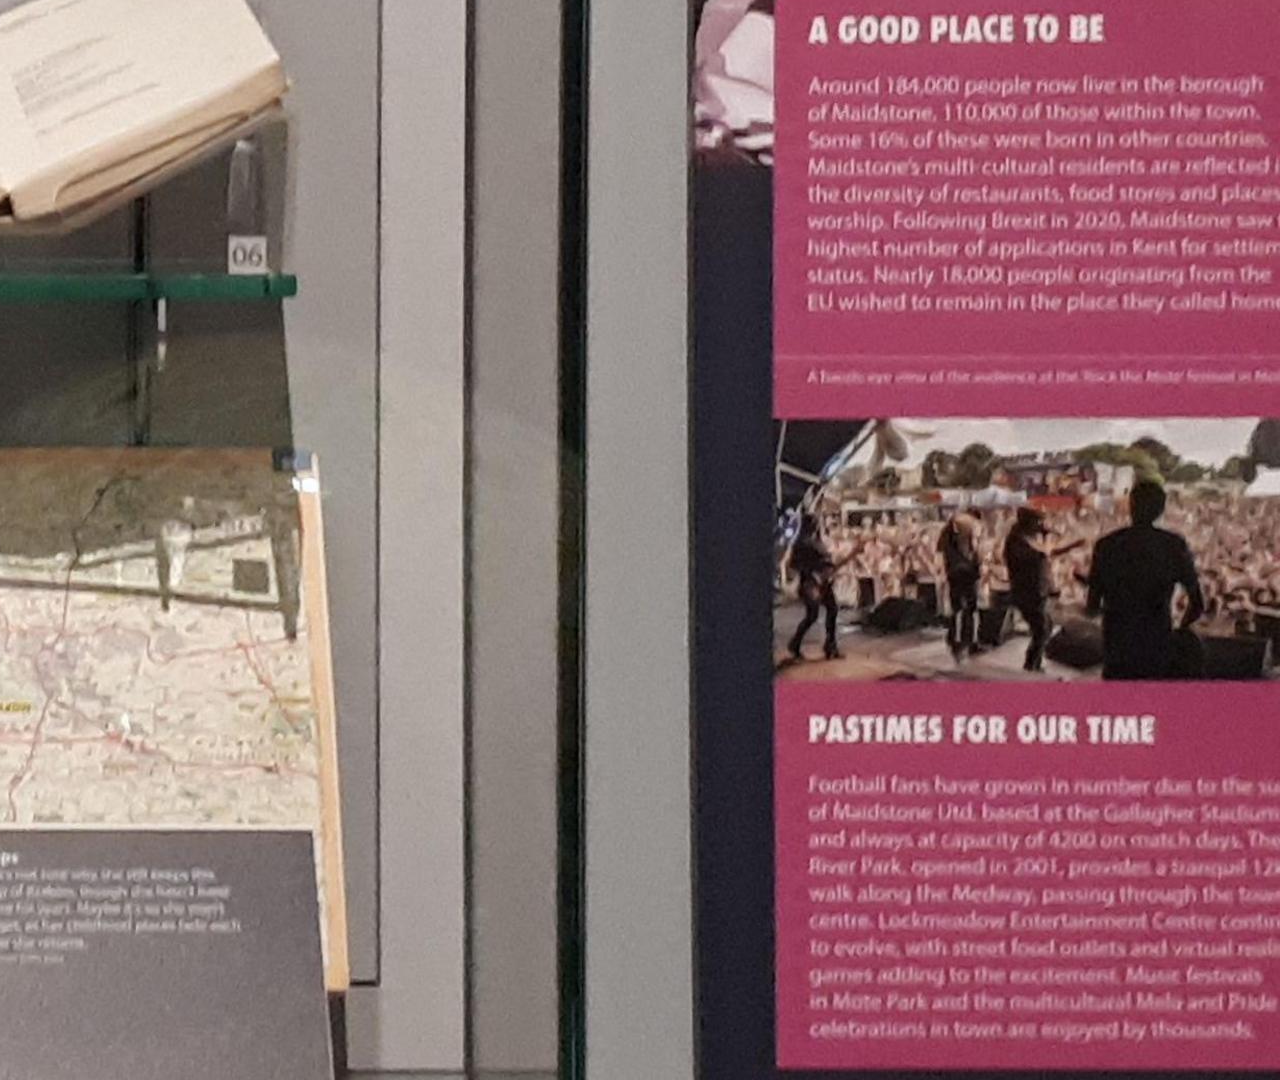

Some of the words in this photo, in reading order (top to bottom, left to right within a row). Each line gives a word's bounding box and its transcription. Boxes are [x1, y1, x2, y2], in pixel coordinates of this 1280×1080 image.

[808, 16, 828, 43] A
[838, 15, 920, 44] GOOD
[930, 14, 1014, 43] PLACE
[1024, 14, 1059, 43] TO
[1070, 14, 1104, 43] BE
[809, 76, 879, 95] Around
[964, 76, 1031, 98] people
[1036, 79, 1077, 94] now
[1083, 74, 1116, 93] live
[1121, 75, 1138, 93] in
[1144, 74, 1176, 93] the
[1180, 74, 1264, 98] borough
[808, 103, 826, 121] of
[1022, 102, 1040, 120] of
[1046, 103, 1099, 120] those
[1104, 102, 1164, 120] within
[1170, 101, 1201, 120] the
[808, 130, 862, 149] Some
[870, 131, 908, 149] 16%
[913, 129, 934, 149] of
[938, 130, 989, 149] these
[995, 133, 1040, 149] were
[1046, 129, 1090, 147] born
[1097, 130, 1114, 147] in
[1119, 129, 1170, 147] other
[1060, 155, 1145, 175] residents
[1150, 159, 1181, 174] are
[1186, 155, 1270, 175] reflected
[808, 185, 840, 203] the
[844, 184, 924, 207] diversity
[930, 184, 948, 203] of
[1070, 183, 1114, 202] food
[1119, 186, 1175, 202] stores
[1180, 184, 1217, 202] and
[232, 244, 262, 266] 06
[807, 239, 880, 259] highest
[884, 238, 959, 257] number
[965, 238, 985, 257] of
[989, 238, 1105, 261] applications
[1110, 240, 1127, 256] in
[1133, 238, 1177, 256] Kent
[1181, 238, 1208, 256] for
[807, 292, 833, 311] EU
[840, 293, 906, 311] wished
[912, 295, 930, 311] to
[936, 294, 1002, 311] remain
[1008, 294, 1024, 311] in
[1031, 293, 1061, 310] the
[1067, 293, 1118, 312] place
[1122, 293, 1164, 313] they
[1171, 290, 1226, 310] called
[808, 714, 942, 744] PASTIMES
[953, 715, 1007, 744] FOR
[1017, 715, 1078, 744] OUR
[1087, 715, 1155, 744] TIME
